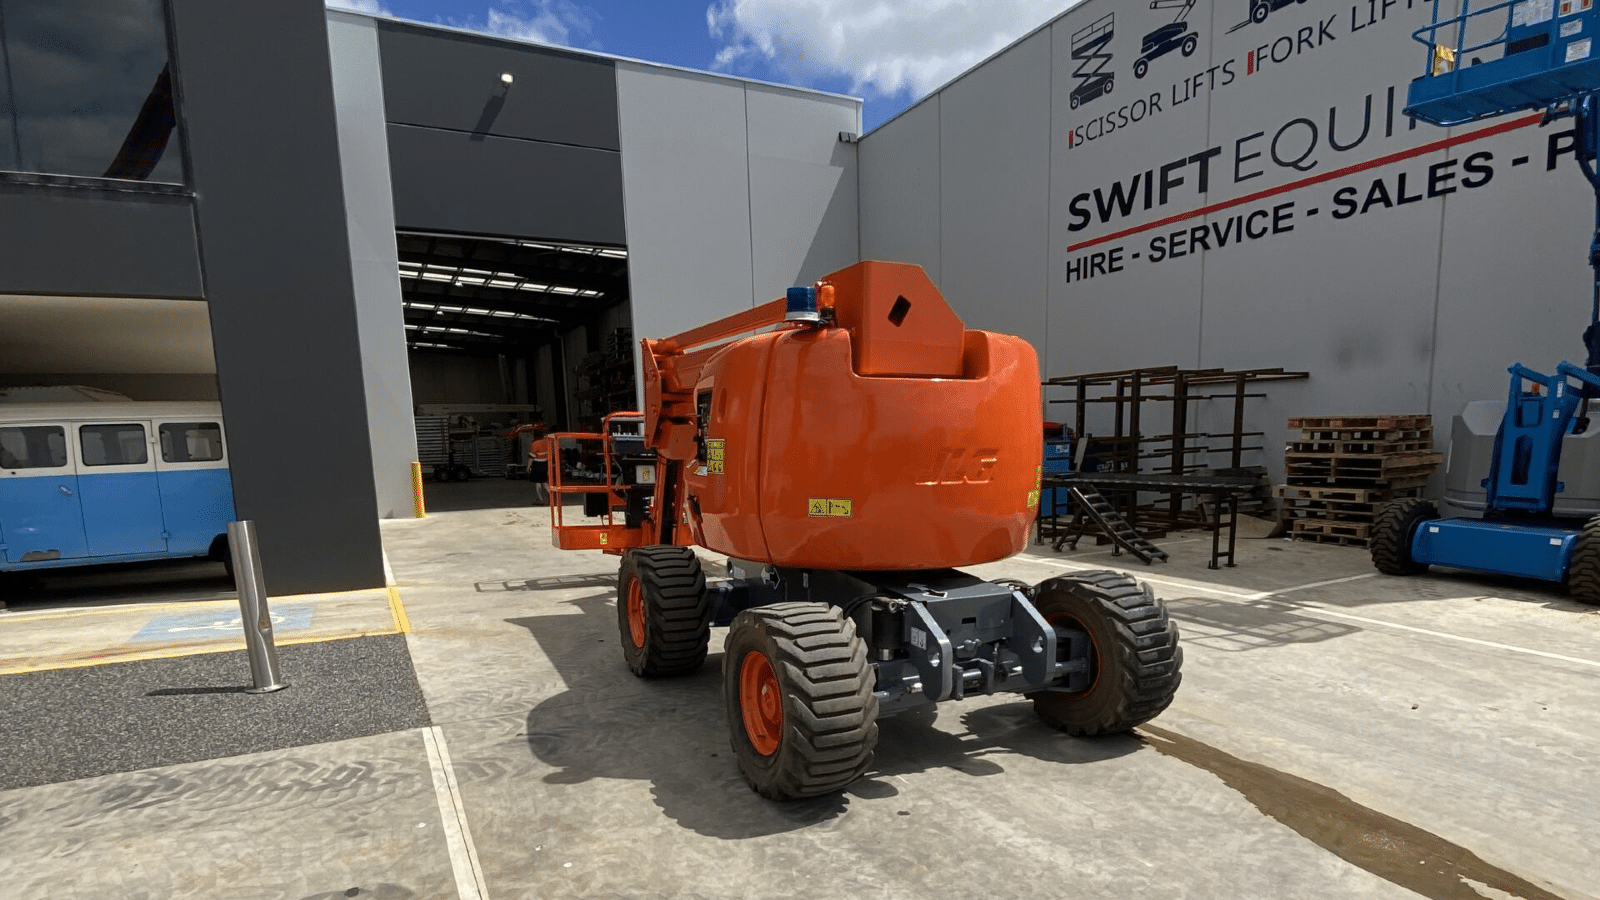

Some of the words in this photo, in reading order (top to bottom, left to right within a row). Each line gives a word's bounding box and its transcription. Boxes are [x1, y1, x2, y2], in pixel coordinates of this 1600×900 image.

[1075, 92, 1162, 147] SCISSOR
[1172, 59, 1235, 106] LIFTS
[1256, 14, 1337, 72] FORK
[1351, 0, 1434, 33] LIF
[1066, 247, 1124, 284] HIRE
[1148, 201, 1295, 263] SERVICE
[1331, 151, 1494, 220] SALES
[1067, 145, 1222, 232] SWIFT
